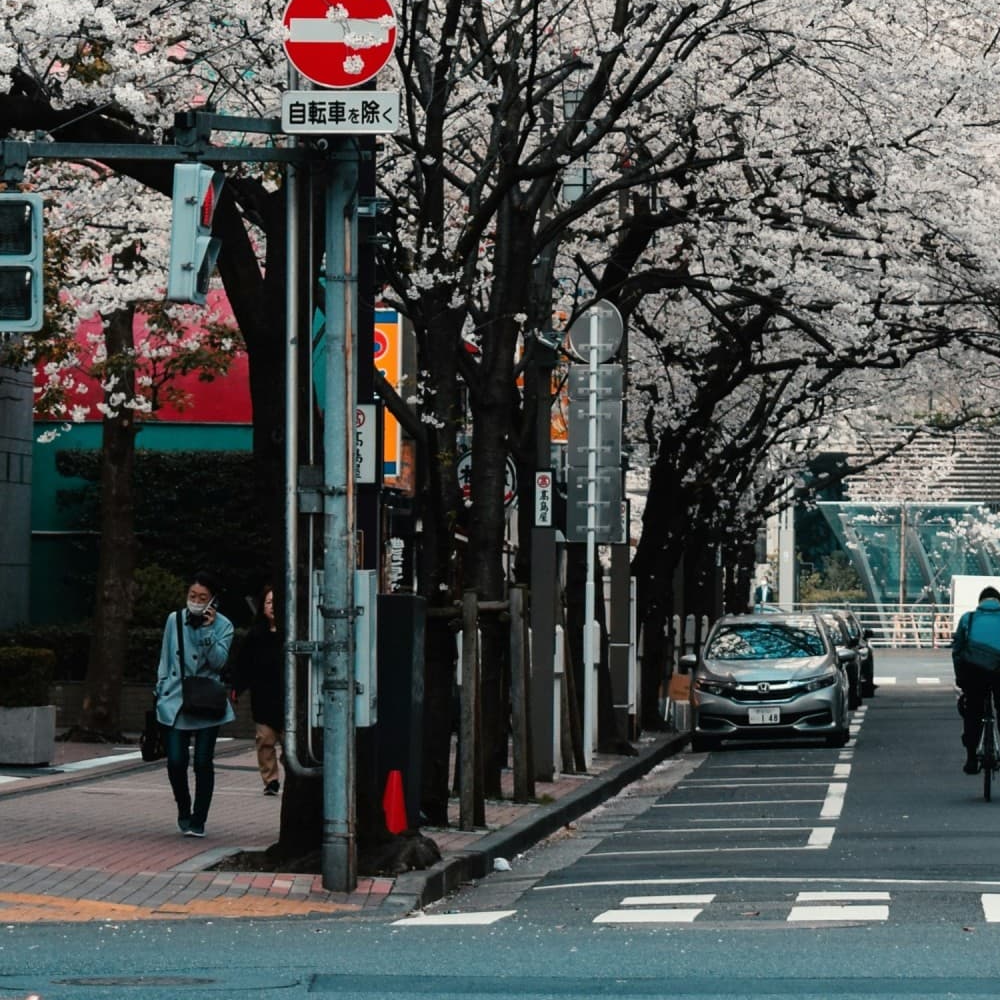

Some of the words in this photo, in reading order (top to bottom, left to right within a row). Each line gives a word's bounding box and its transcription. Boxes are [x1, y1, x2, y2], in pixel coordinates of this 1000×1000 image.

[289, 100, 392, 125] 自転車を除く
